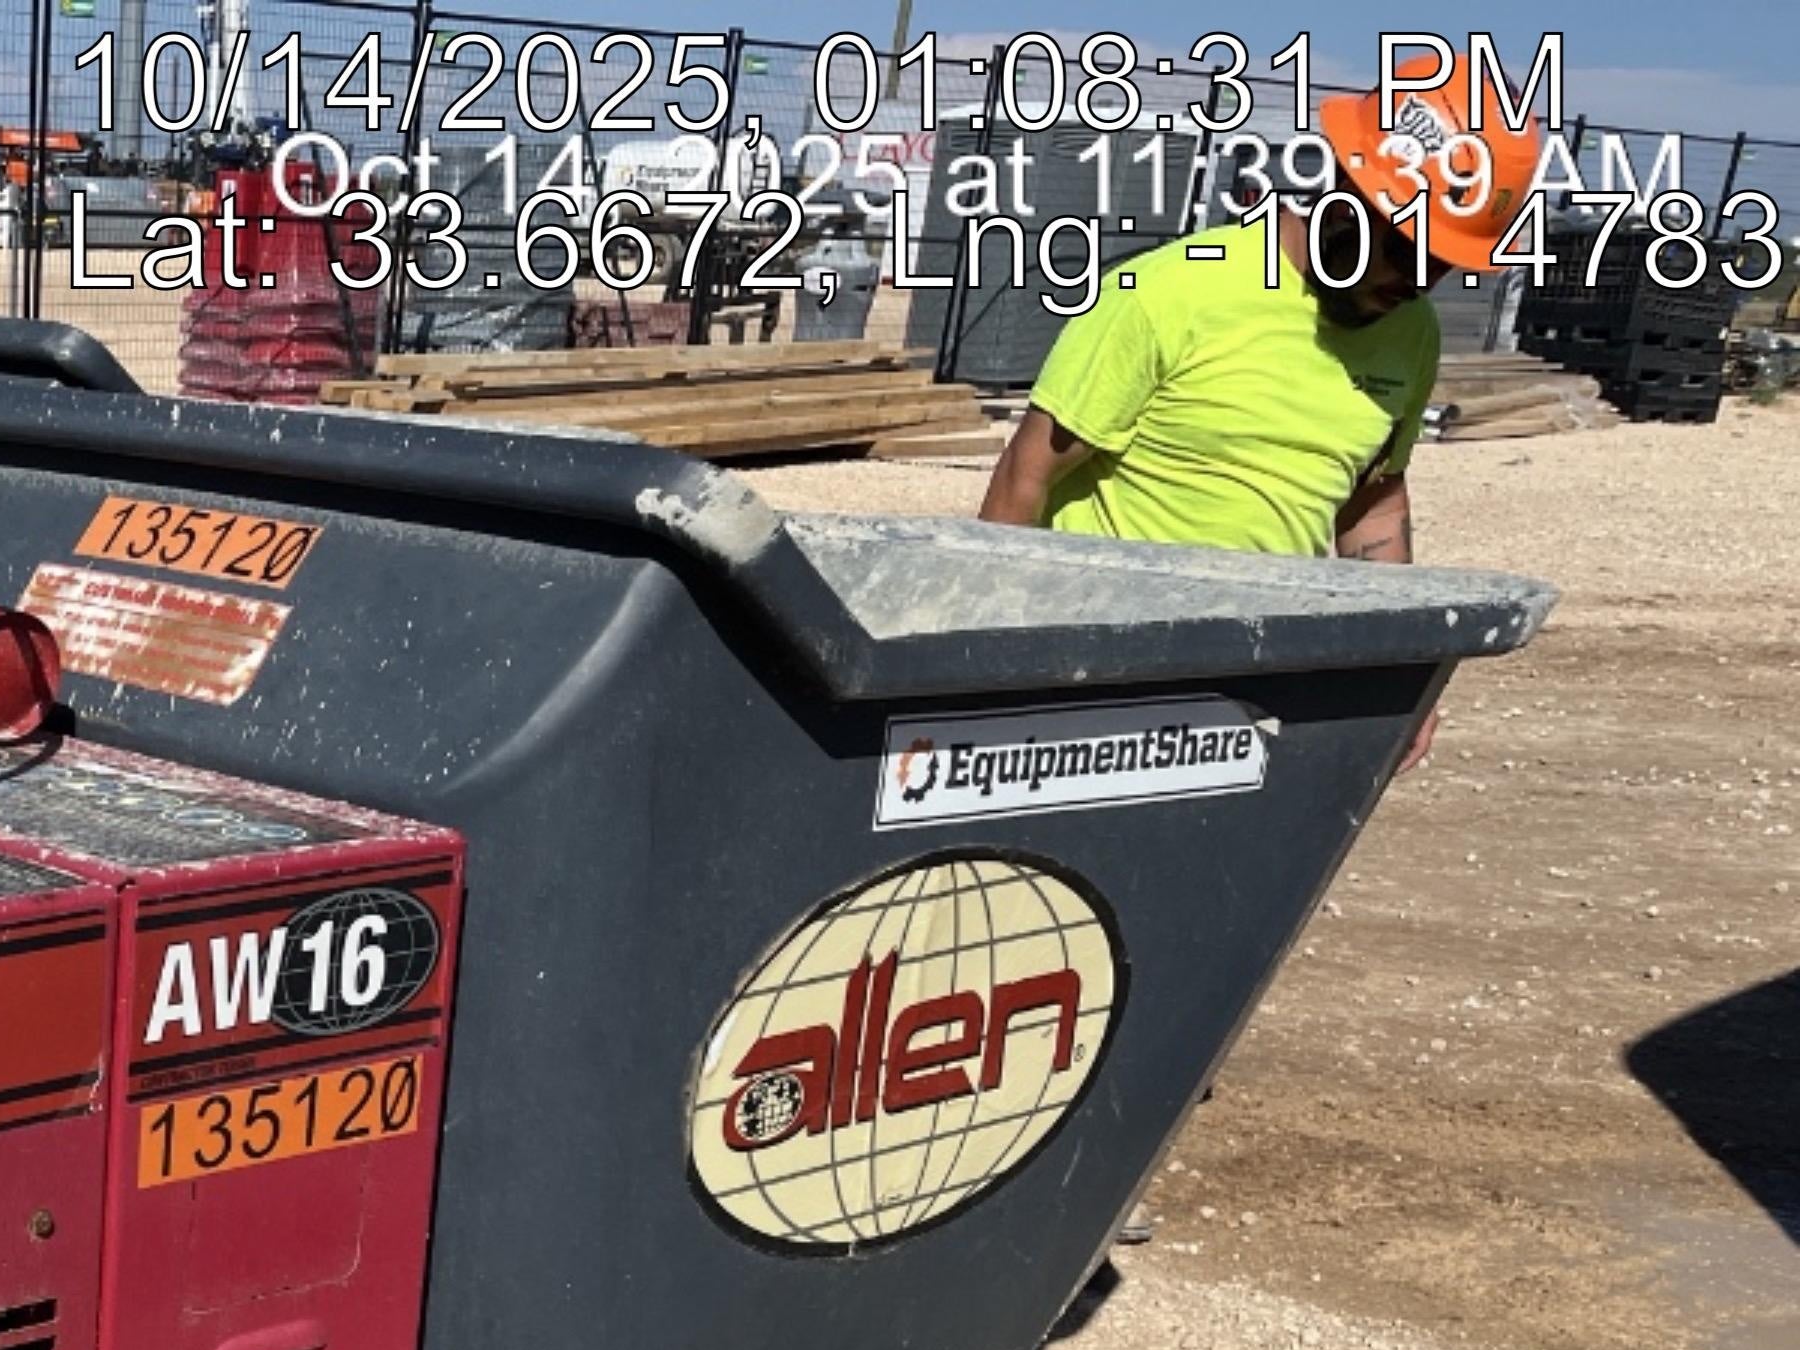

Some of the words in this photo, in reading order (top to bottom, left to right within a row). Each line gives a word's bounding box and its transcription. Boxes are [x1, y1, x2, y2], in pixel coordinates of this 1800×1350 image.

[102, 503, 317, 583] 135120
[945, 724, 1253, 795] EquipmentShare
[144, 931, 286, 1044] AW
[300, 914, 389, 1012] 16
[722, 947, 1083, 1151] allen
[149, 1057, 417, 1177] 135120
